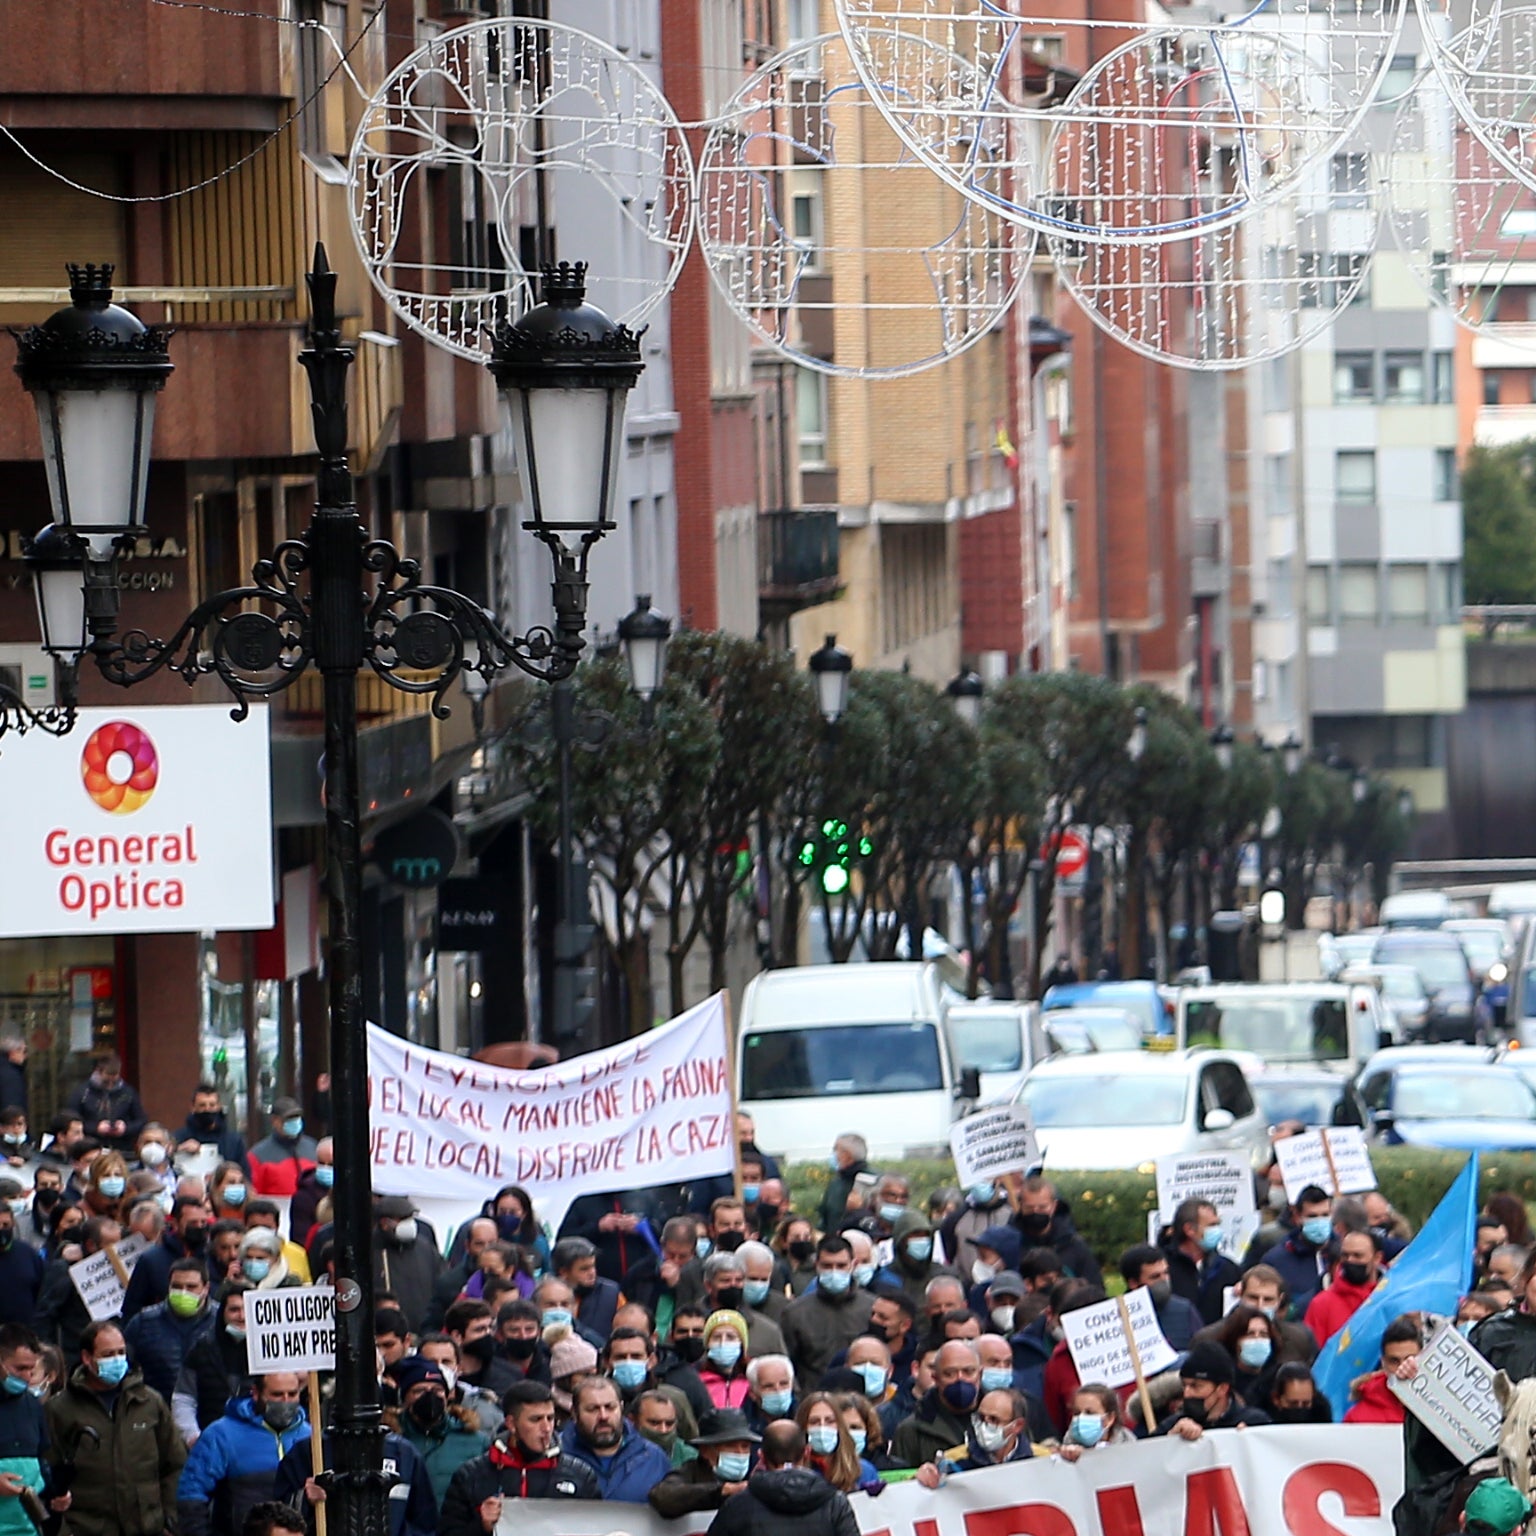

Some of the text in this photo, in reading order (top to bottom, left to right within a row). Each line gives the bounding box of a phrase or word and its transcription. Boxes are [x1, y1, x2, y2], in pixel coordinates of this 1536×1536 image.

[45, 825, 197, 865] General
[59, 870, 184, 919] Optica
[382, 1056, 729, 1133] EL LOCAL MANTIENE LA FAUNA
[393, 1130, 416, 1166] EL
[425, 1135, 503, 1178] LOCAL
[517, 1135, 624, 1181] DISFRUTE
[636, 1126, 662, 1165] LA
[668, 1114, 732, 1157] CAZA
[255, 1299, 282, 1325] CON
[261, 1333, 281, 1359] NO
[284, 1331, 307, 1358] HAY
